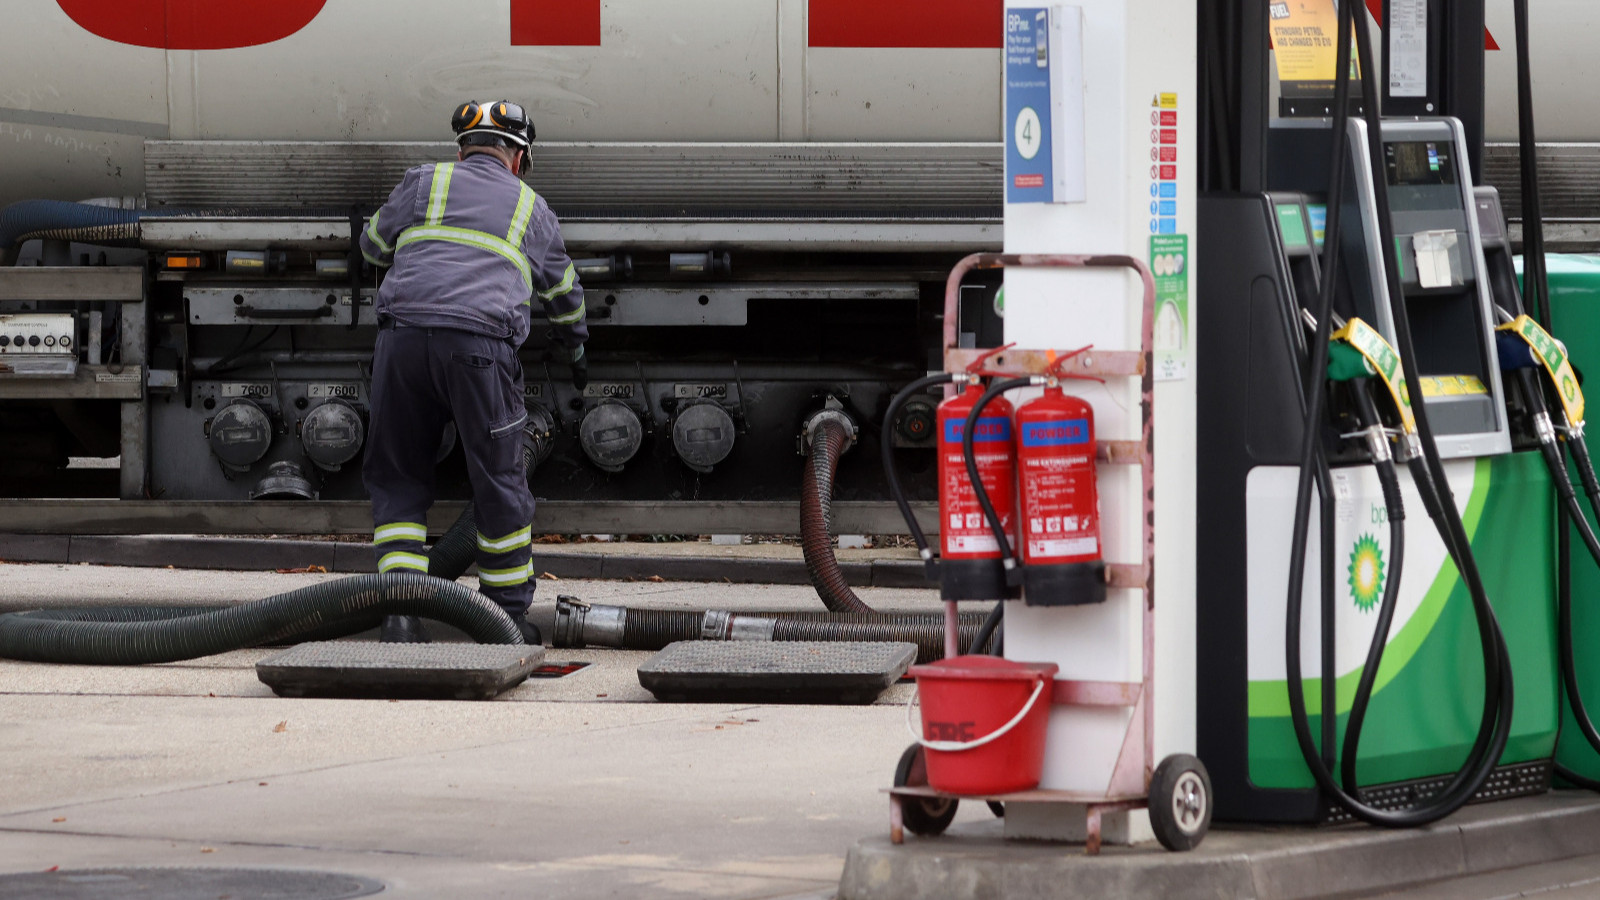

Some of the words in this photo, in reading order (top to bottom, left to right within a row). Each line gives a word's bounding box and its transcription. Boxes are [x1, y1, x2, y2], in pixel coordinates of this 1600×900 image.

[1270, 4, 1289, 18] FUEL
[1303, 26, 1324, 36] PETROL
[1277, 37, 1288, 47] HAS
[1022, 119, 1032, 145] 4
[241, 385, 269, 396] 7600
[313, 386, 319, 395] 2
[327, 385, 356, 396] 7600
[525, 386, 539, 396] 00
[603, 385, 631, 396] 6000
[680, 387, 687, 395] 6
[697, 386, 725, 396] 7000
[1030, 426, 1081, 440] POWDER
[1371, 502, 1388, 529] bp
[928, 722, 975, 742] FIRE
